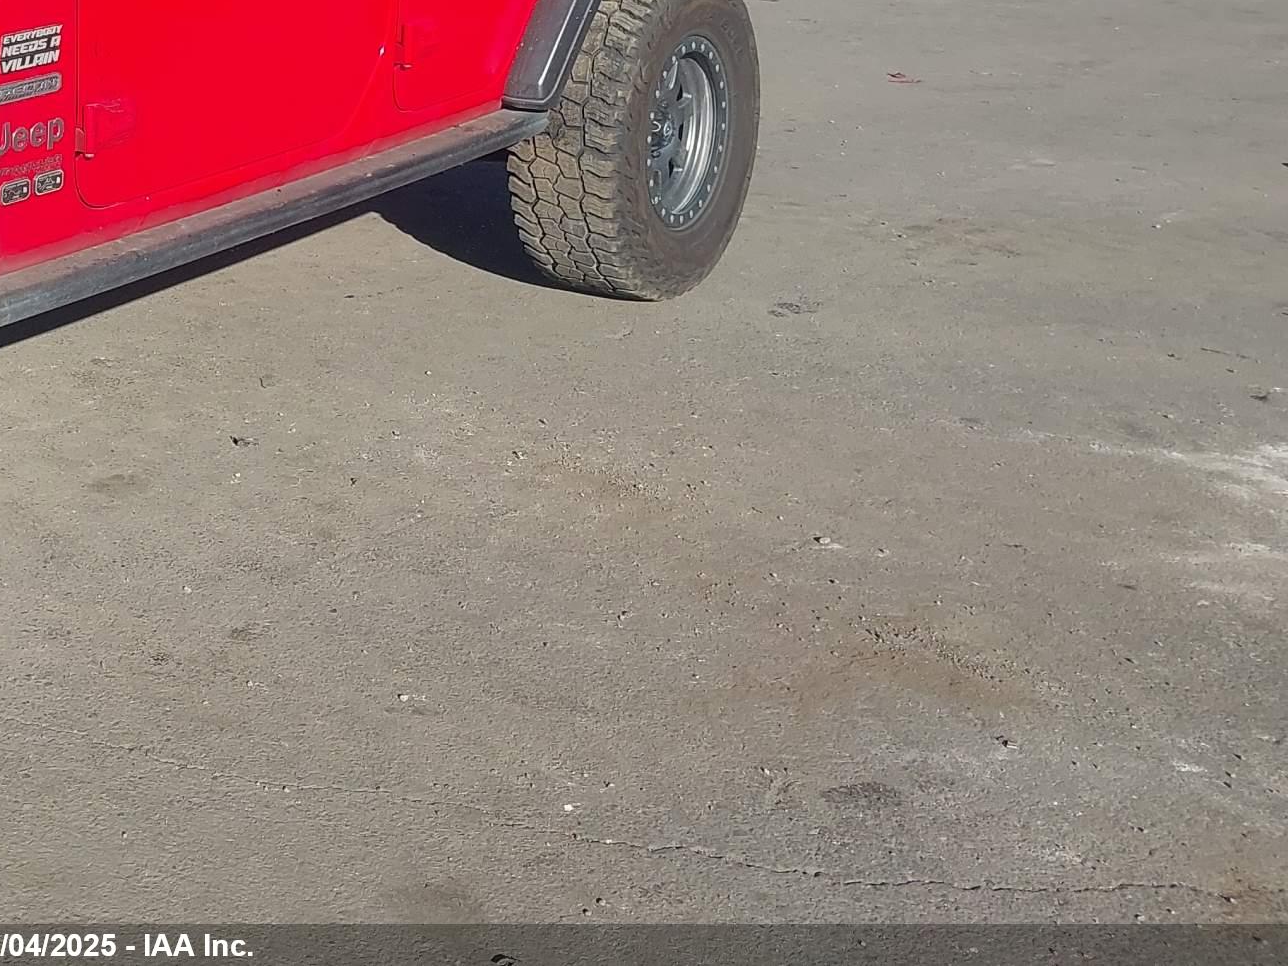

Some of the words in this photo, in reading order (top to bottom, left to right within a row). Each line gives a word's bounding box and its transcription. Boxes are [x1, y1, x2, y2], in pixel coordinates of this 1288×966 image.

[3, 24, 63, 45] EVERYBODY
[1, 38, 48, 58] NEEDS
[49, 35, 62, 48] A
[0, 49, 61, 74] VILLAIN
